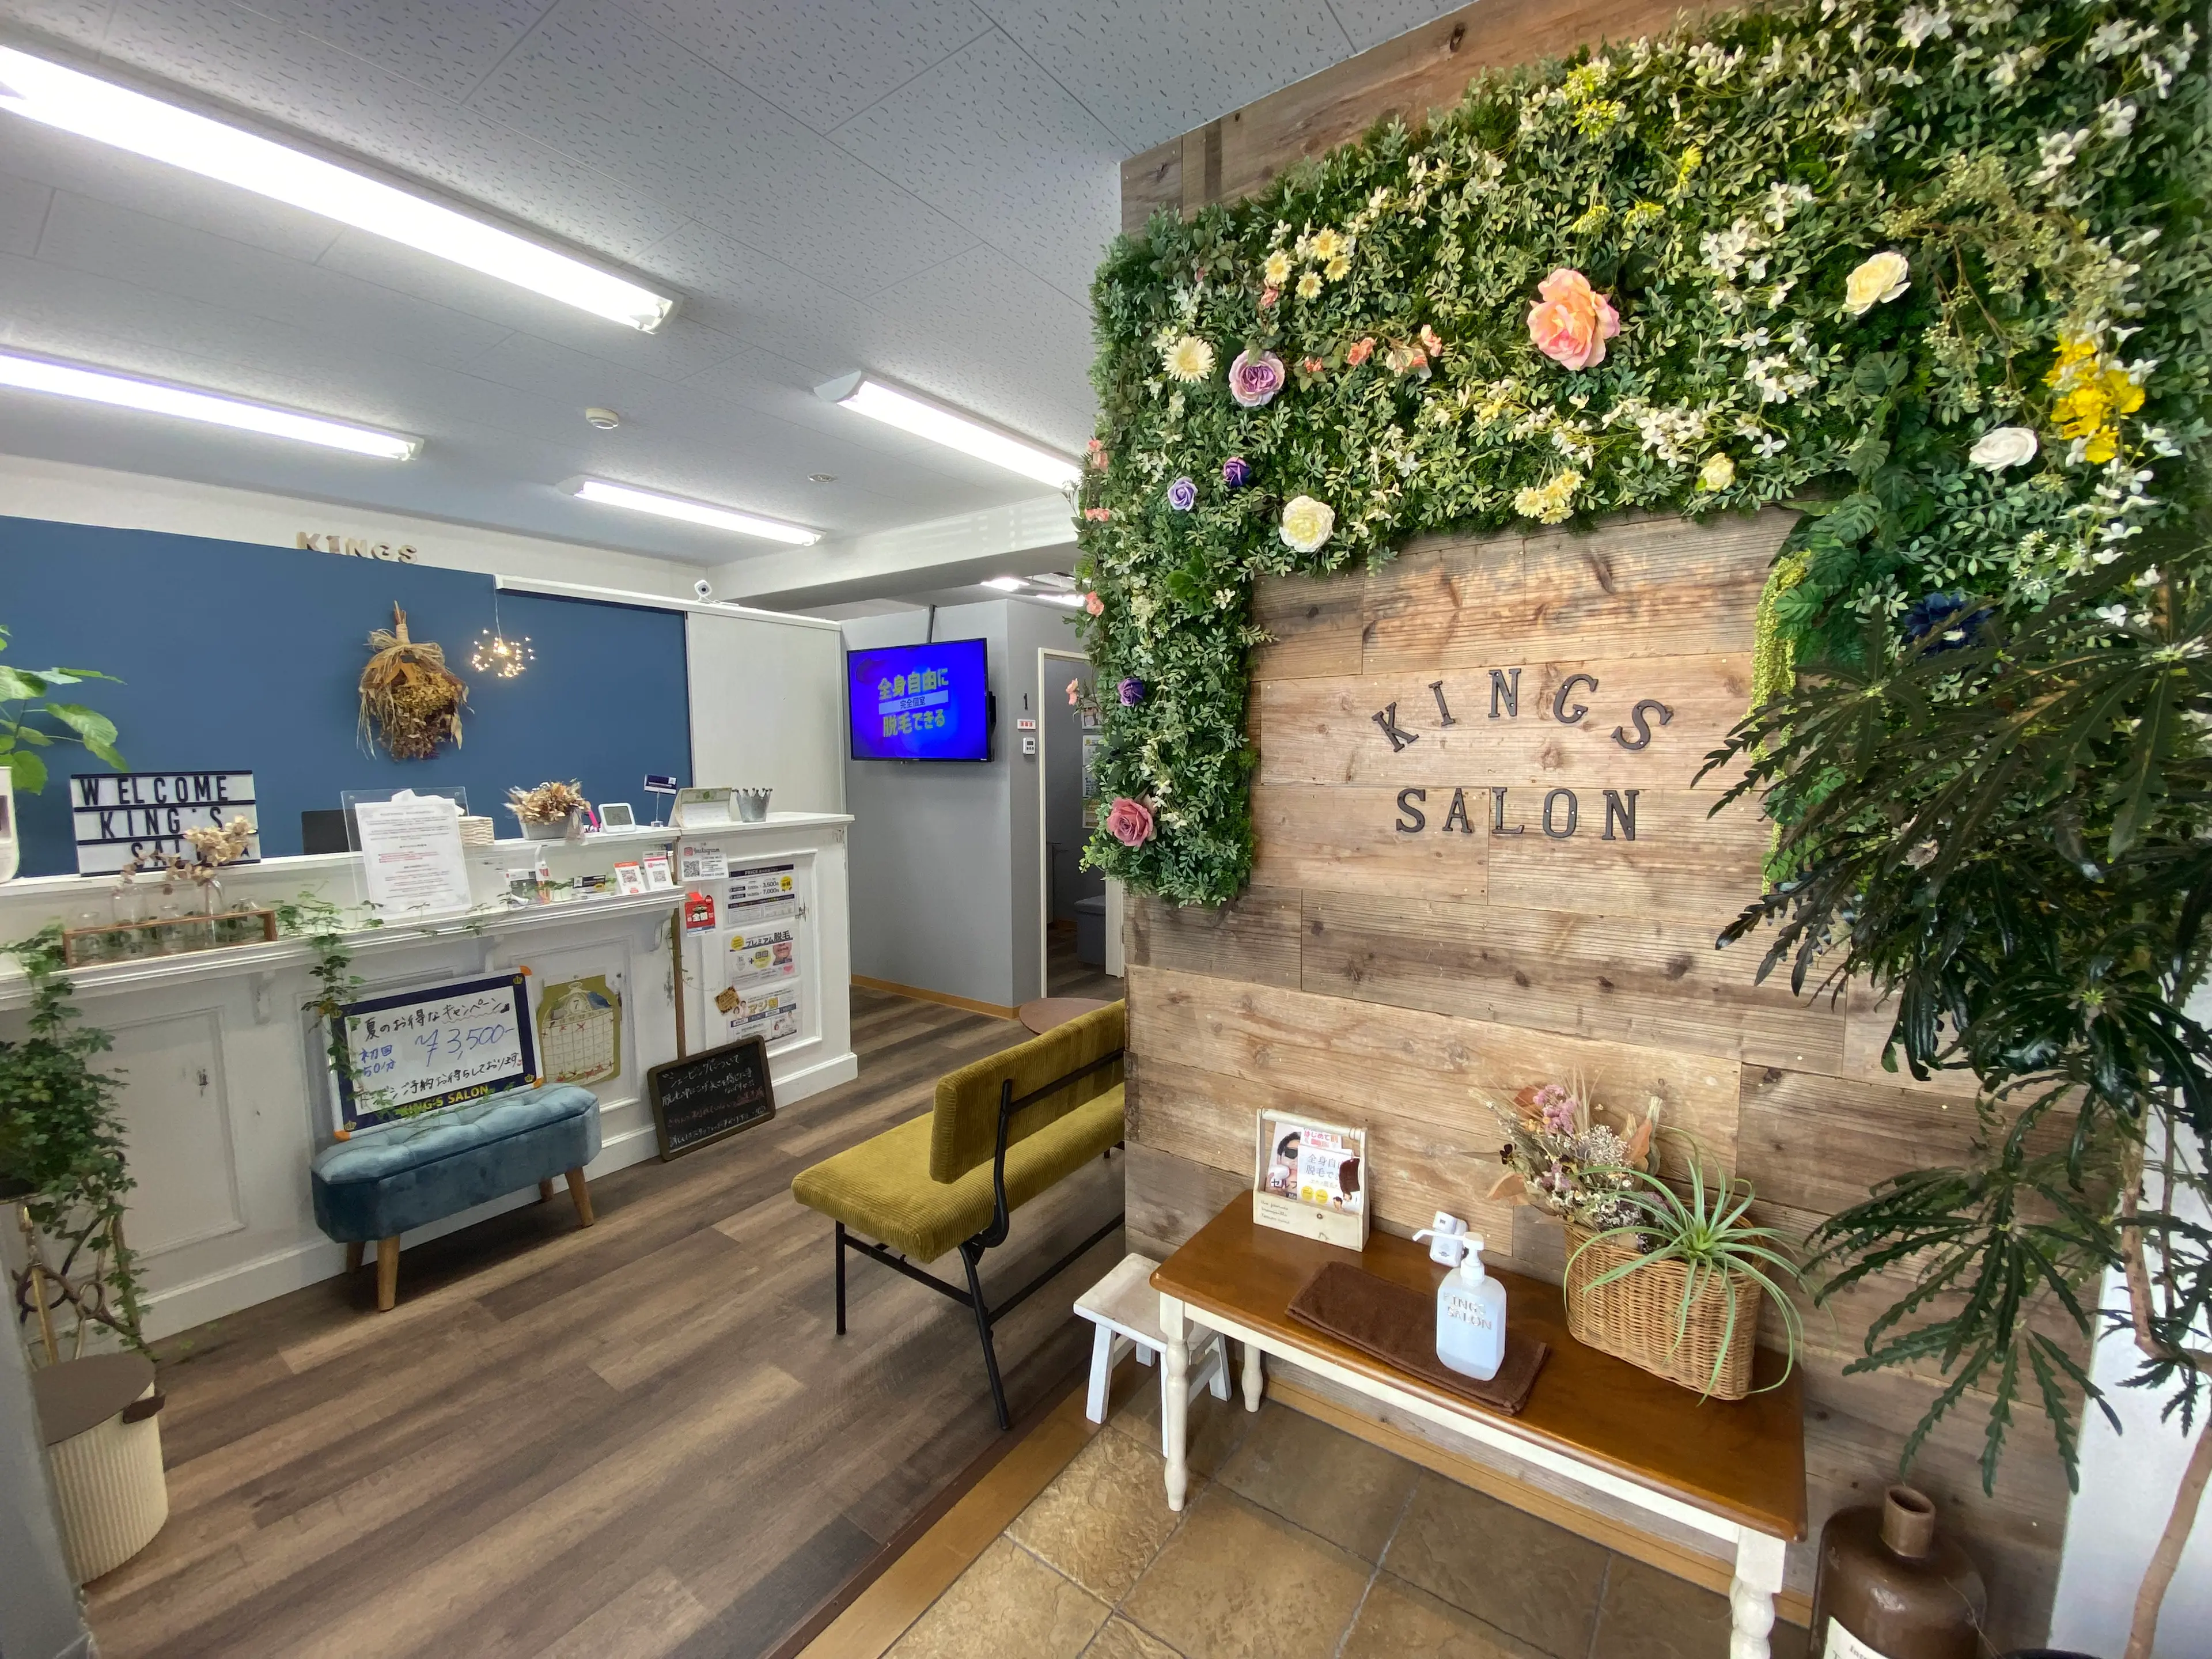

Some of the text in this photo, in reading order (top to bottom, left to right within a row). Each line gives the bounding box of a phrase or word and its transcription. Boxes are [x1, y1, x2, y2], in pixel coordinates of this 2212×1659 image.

[296, 532, 417, 564] KINGS
[877, 667, 949, 700] 全身自由に
[900, 696, 926, 710] 完全個室
[1372, 668, 1674, 752] KINGS
[882, 709, 945, 737] 脱毛できる
[80, 775, 228, 806] WELCOME
[1396, 787, 1639, 841] SALON
[745, 930, 790, 947] プレミアム脱毛
[574, 999, 579, 1010] 7
[448, 1085, 488, 1104] SALON
[1307, 1154, 1340, 1169] 全身自
[1447, 1306, 1492, 1331] SALON
